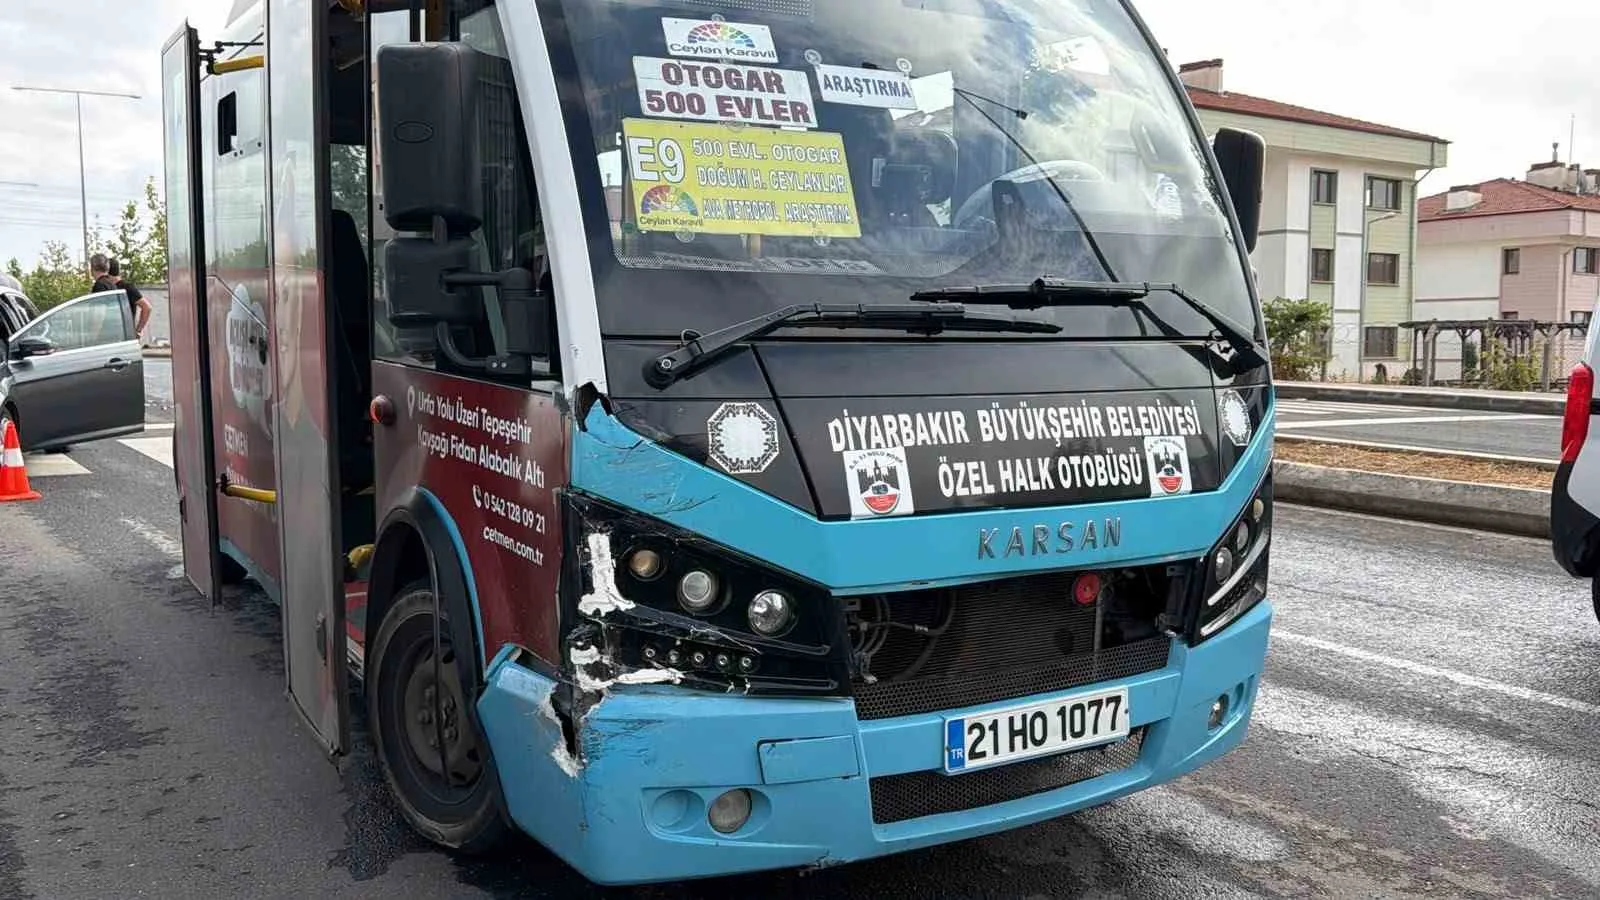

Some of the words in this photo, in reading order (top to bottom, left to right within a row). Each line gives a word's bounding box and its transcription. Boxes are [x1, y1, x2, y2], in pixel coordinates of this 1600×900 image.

[670, 43, 721, 55] Ceylan
[725, 47, 776, 58] Karavil
[661, 62, 786, 94] OTOGAR
[823, 74, 912, 99] ARAŞTIRMA
[645, 89, 706, 115] 500
[715, 94, 810, 125] EVLER
[627, 136, 685, 184] E9
[692, 139, 723, 158] 500
[728, 141, 767, 160] EVL.
[772, 144, 841, 164] OTOGAR
[697, 162, 748, 188] DOĞUM
[752, 168, 767, 189] H.
[769, 170, 849, 193] CEYLANLAR
[639, 216, 672, 227] Ceylan
[674, 216, 703, 227] Karavil
[418, 391, 435, 415] Urfa
[436, 397, 455, 421] Yolu
[456, 398, 479, 428] Üzeri
[481, 408, 532, 444] Tepeşehir
[828, 409, 970, 452] DİYARBAKIR
[978, 400, 1104, 447] BÜYÜKŞEHİR
[1106, 398, 1202, 437] BELEDİYESİ
[417, 424, 449, 459] Kavşağı
[450, 432, 477, 464] Fidan
[479, 444, 522, 481] Alabalık
[524, 460, 545, 489] Altı
[938, 456, 995, 497] ÖZEL
[999, 453, 1056, 494] HALK
[1058, 448, 1144, 490] OTOBÜSÜ
[483, 492, 490, 507] 0
[489, 494, 506, 518] 542
[506, 499, 521, 525] 128
[522, 506, 534, 529] 09
[535, 511, 546, 535] 21
[483, 525, 544, 566] cetmen.com.tr
[977, 517, 1121, 560] KARSAN
[950, 748, 964, 760] TR
[967, 718, 1000, 760] 21
[1056, 695, 1122, 741] 1077
